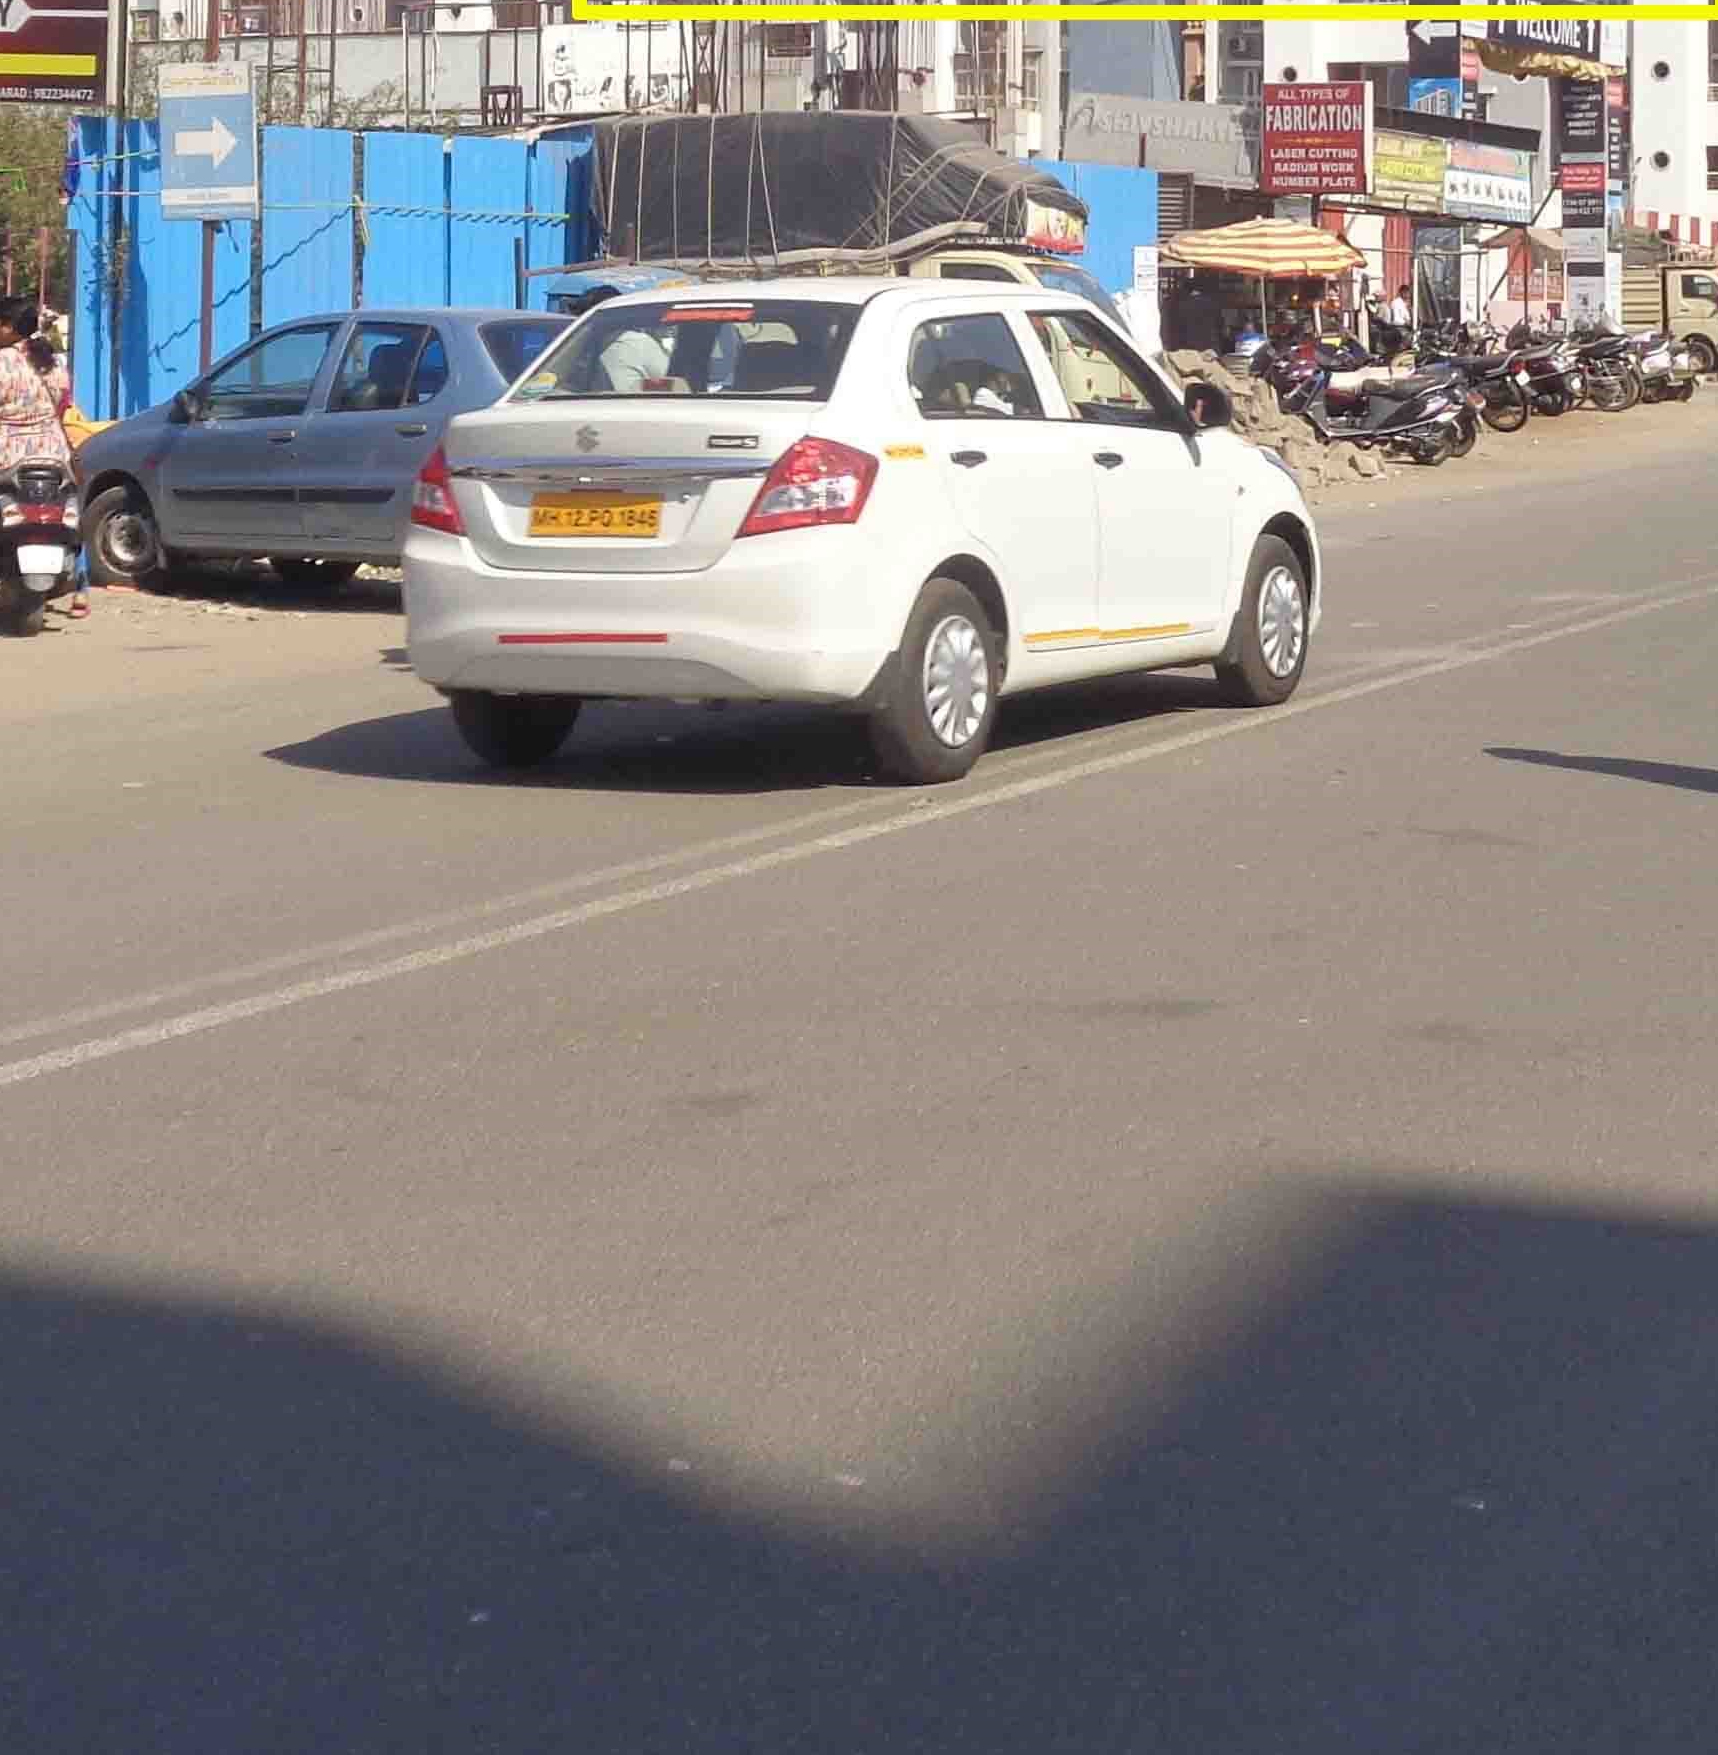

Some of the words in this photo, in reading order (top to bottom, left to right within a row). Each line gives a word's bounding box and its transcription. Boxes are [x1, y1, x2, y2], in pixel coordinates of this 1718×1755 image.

[1278, 88, 1298, 100] ALL
[1300, 88, 1333, 100] TYPES
[1337, 88, 1351, 99] OF
[1265, 104, 1363, 132] FABRICATION
[1270, 148, 1306, 159] LASER
[1309, 148, 1358, 159] CUTTING
[1274, 162, 1317, 173] RADIUM
[1321, 162, 1354, 173] WORK
[1272, 176, 1318, 188] NUMBER
[1322, 175, 1356, 187] PLATE
